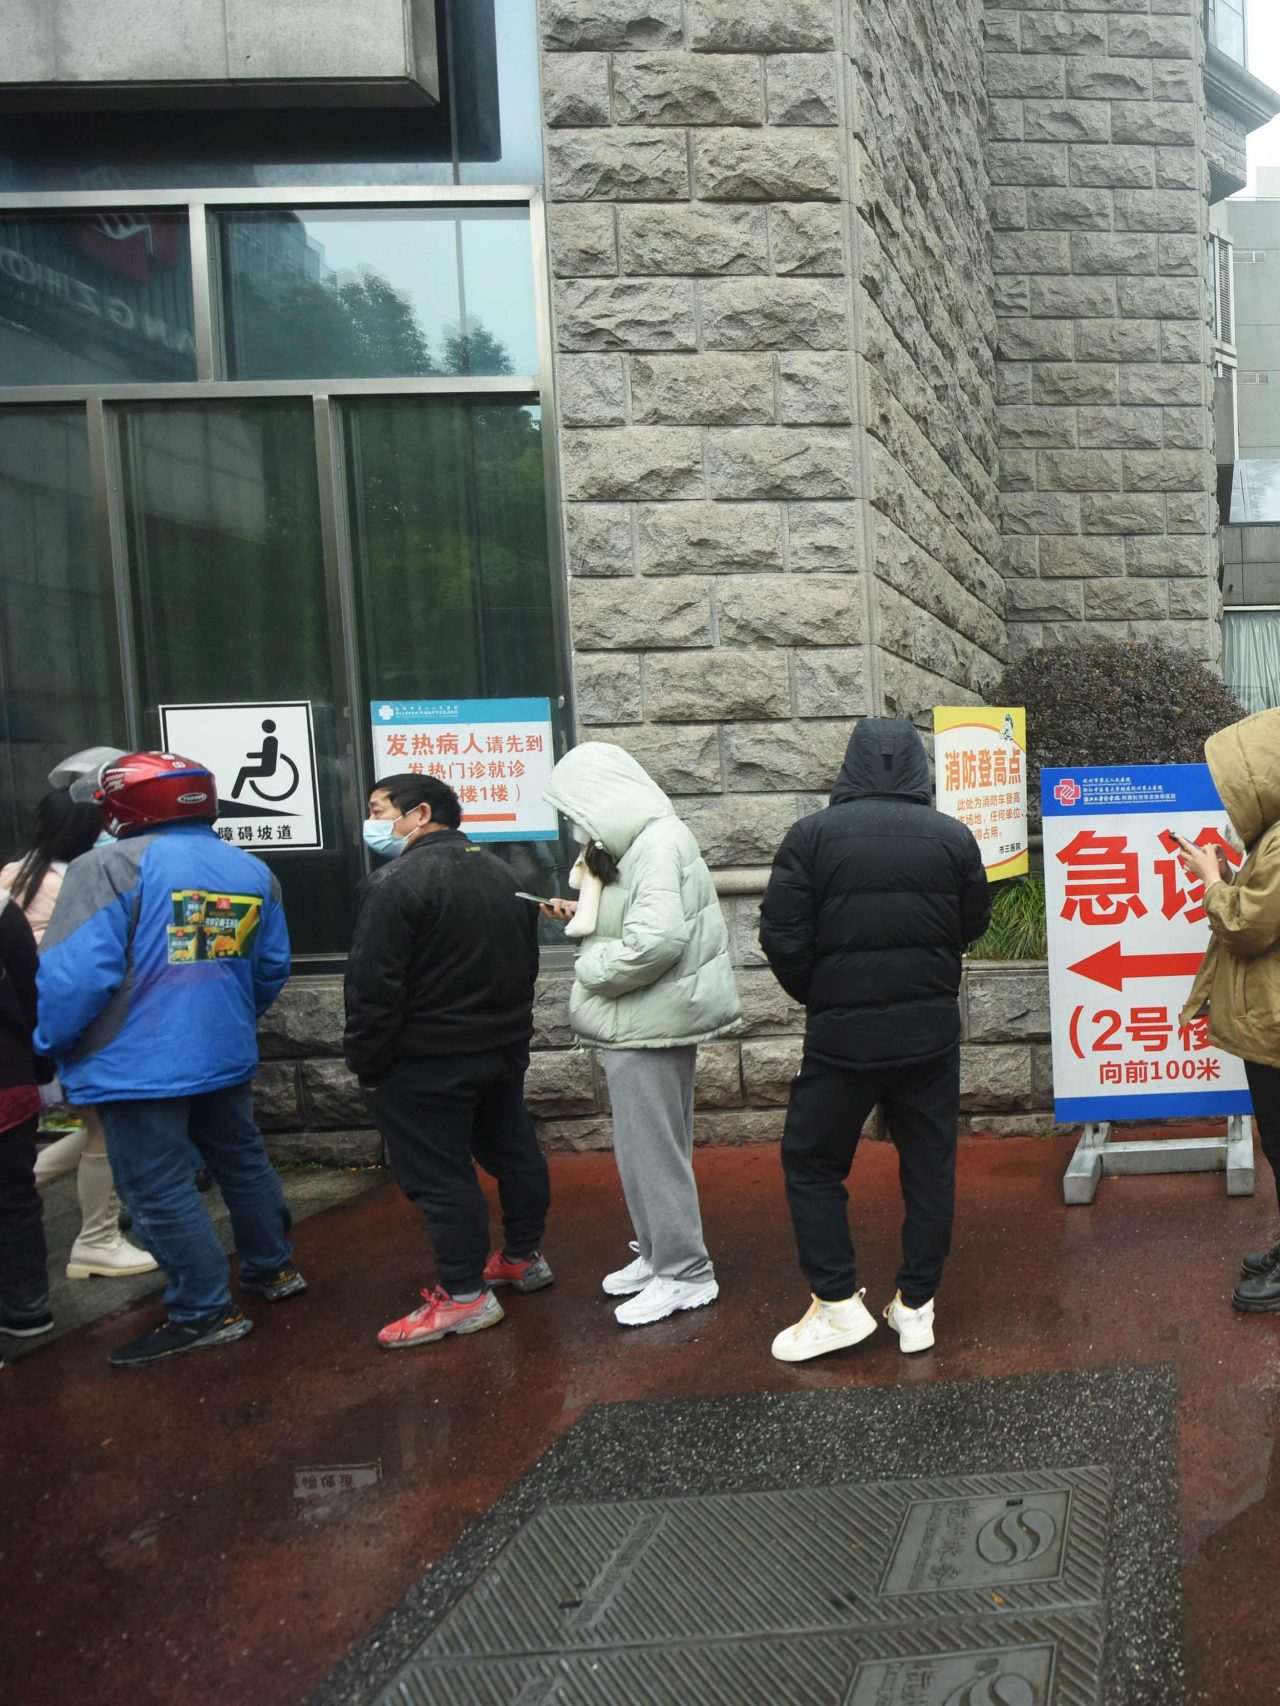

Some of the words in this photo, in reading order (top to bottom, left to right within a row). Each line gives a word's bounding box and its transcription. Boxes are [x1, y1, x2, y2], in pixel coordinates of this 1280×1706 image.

[386, 733, 543, 756] 发热病人请先到
[408, 760, 525, 780] 发热门诊就诊
[945, 747, 1022, 792] 消防登高点
[957, 791, 1021, 811] 此处为消防车登高
[217, 825, 293, 842] 障碍坡道
[999, 842, 1022, 854] 市三医院
[1099, 1057, 1221, 1085] 向前100米
